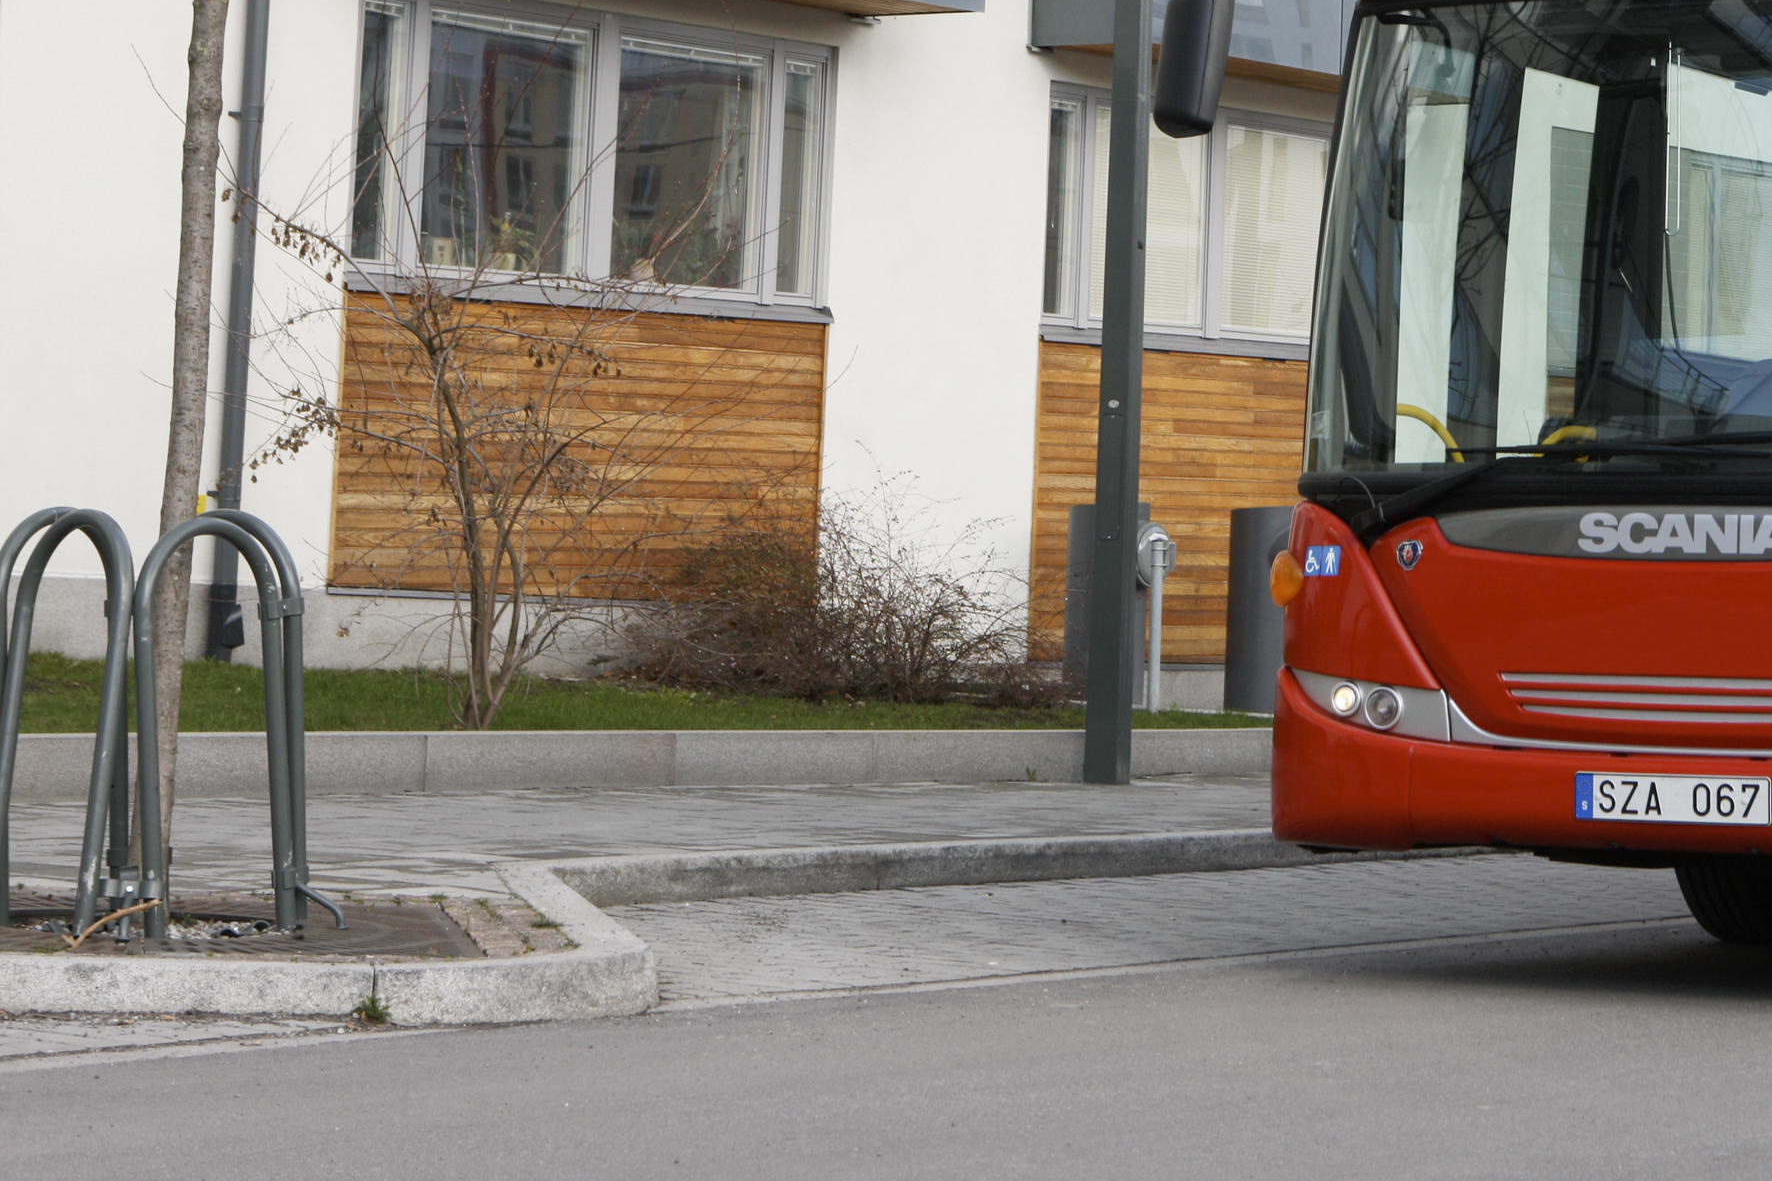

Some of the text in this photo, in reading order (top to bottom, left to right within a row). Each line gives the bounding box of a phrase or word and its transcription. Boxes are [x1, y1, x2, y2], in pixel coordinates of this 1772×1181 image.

[1581, 801, 1588, 810] S
[1599, 780, 1760, 818] SZA 067
